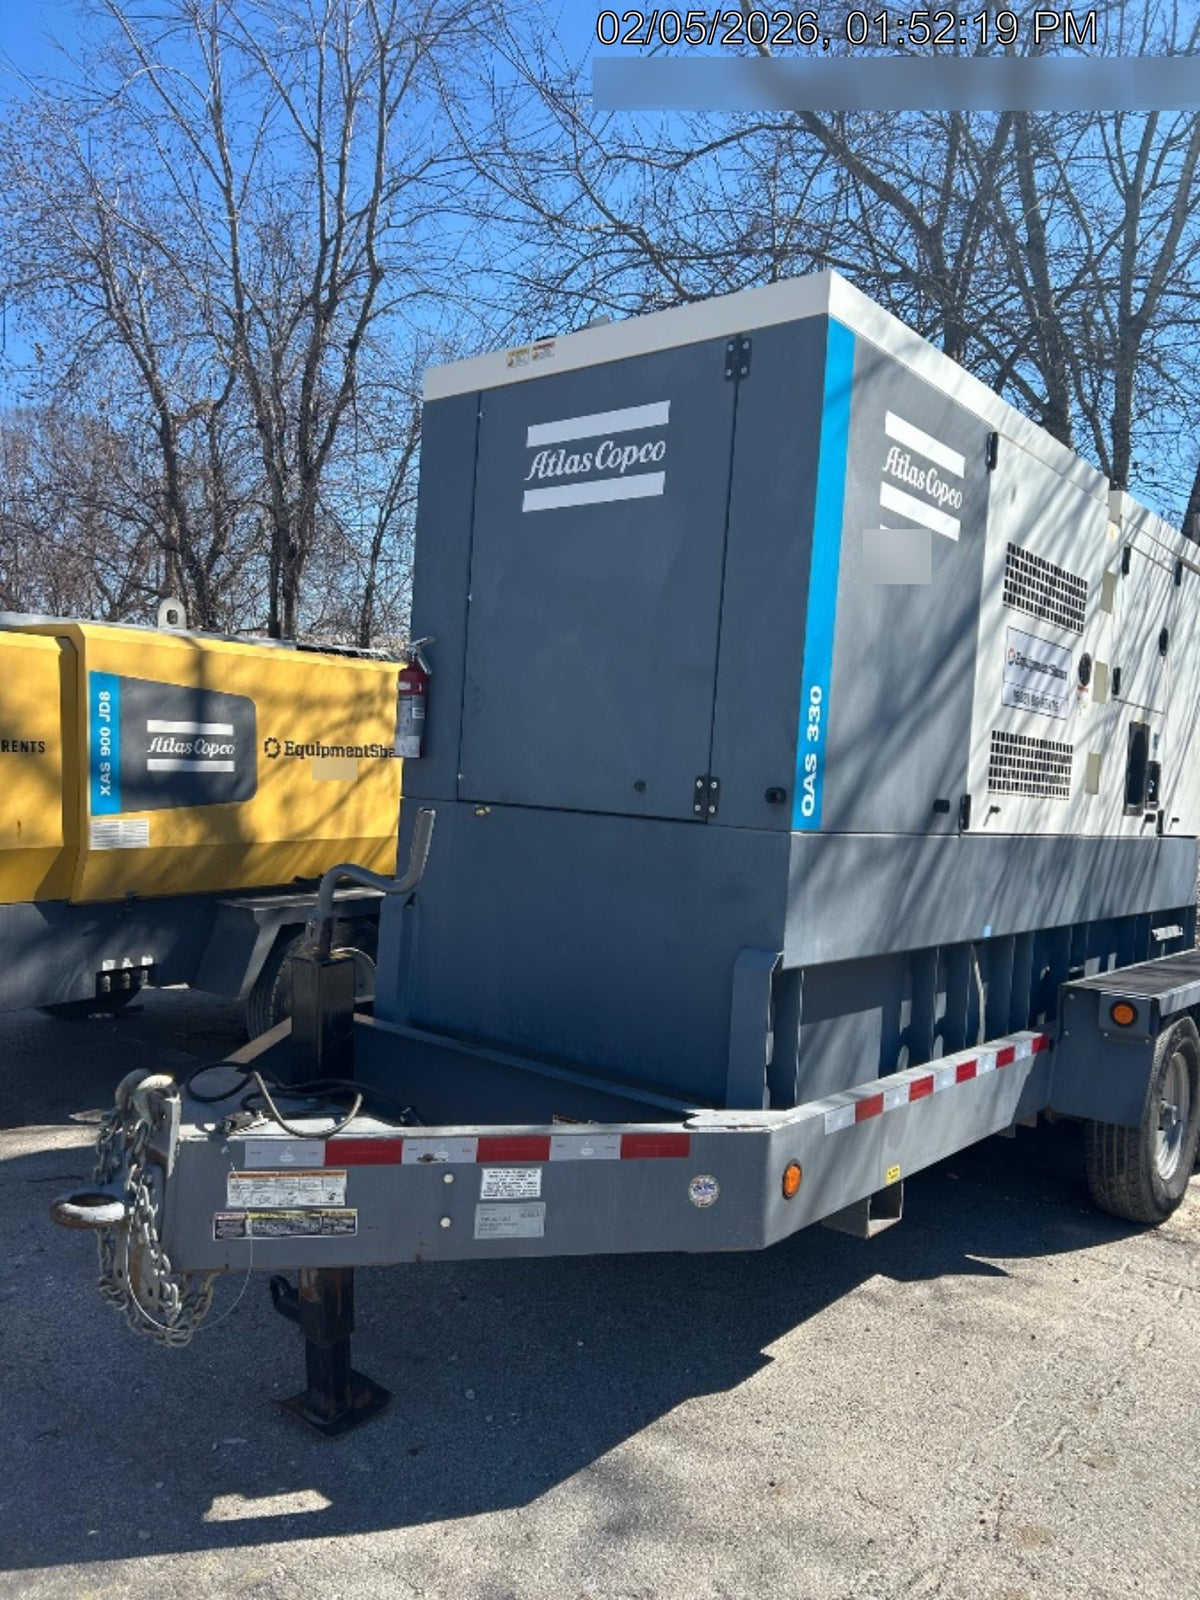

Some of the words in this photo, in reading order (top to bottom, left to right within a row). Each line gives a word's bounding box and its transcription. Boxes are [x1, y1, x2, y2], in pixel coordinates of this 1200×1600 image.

[524, 449, 594, 481] Atlas
[595, 440, 666, 473] Copco
[881, 445, 926, 490] Atlas
[925, 467, 963, 510] Copco
[98, 690, 111, 723] JD8
[806, 685, 823, 743] 330
[0, 738, 46, 754] RENTS
[99, 727, 111, 757] 900
[146, 736, 193, 755] Atlas
[193, 738, 236, 758] Copco
[283, 740, 396, 760] EquipmentSha
[99, 761, 112, 796] XAS
